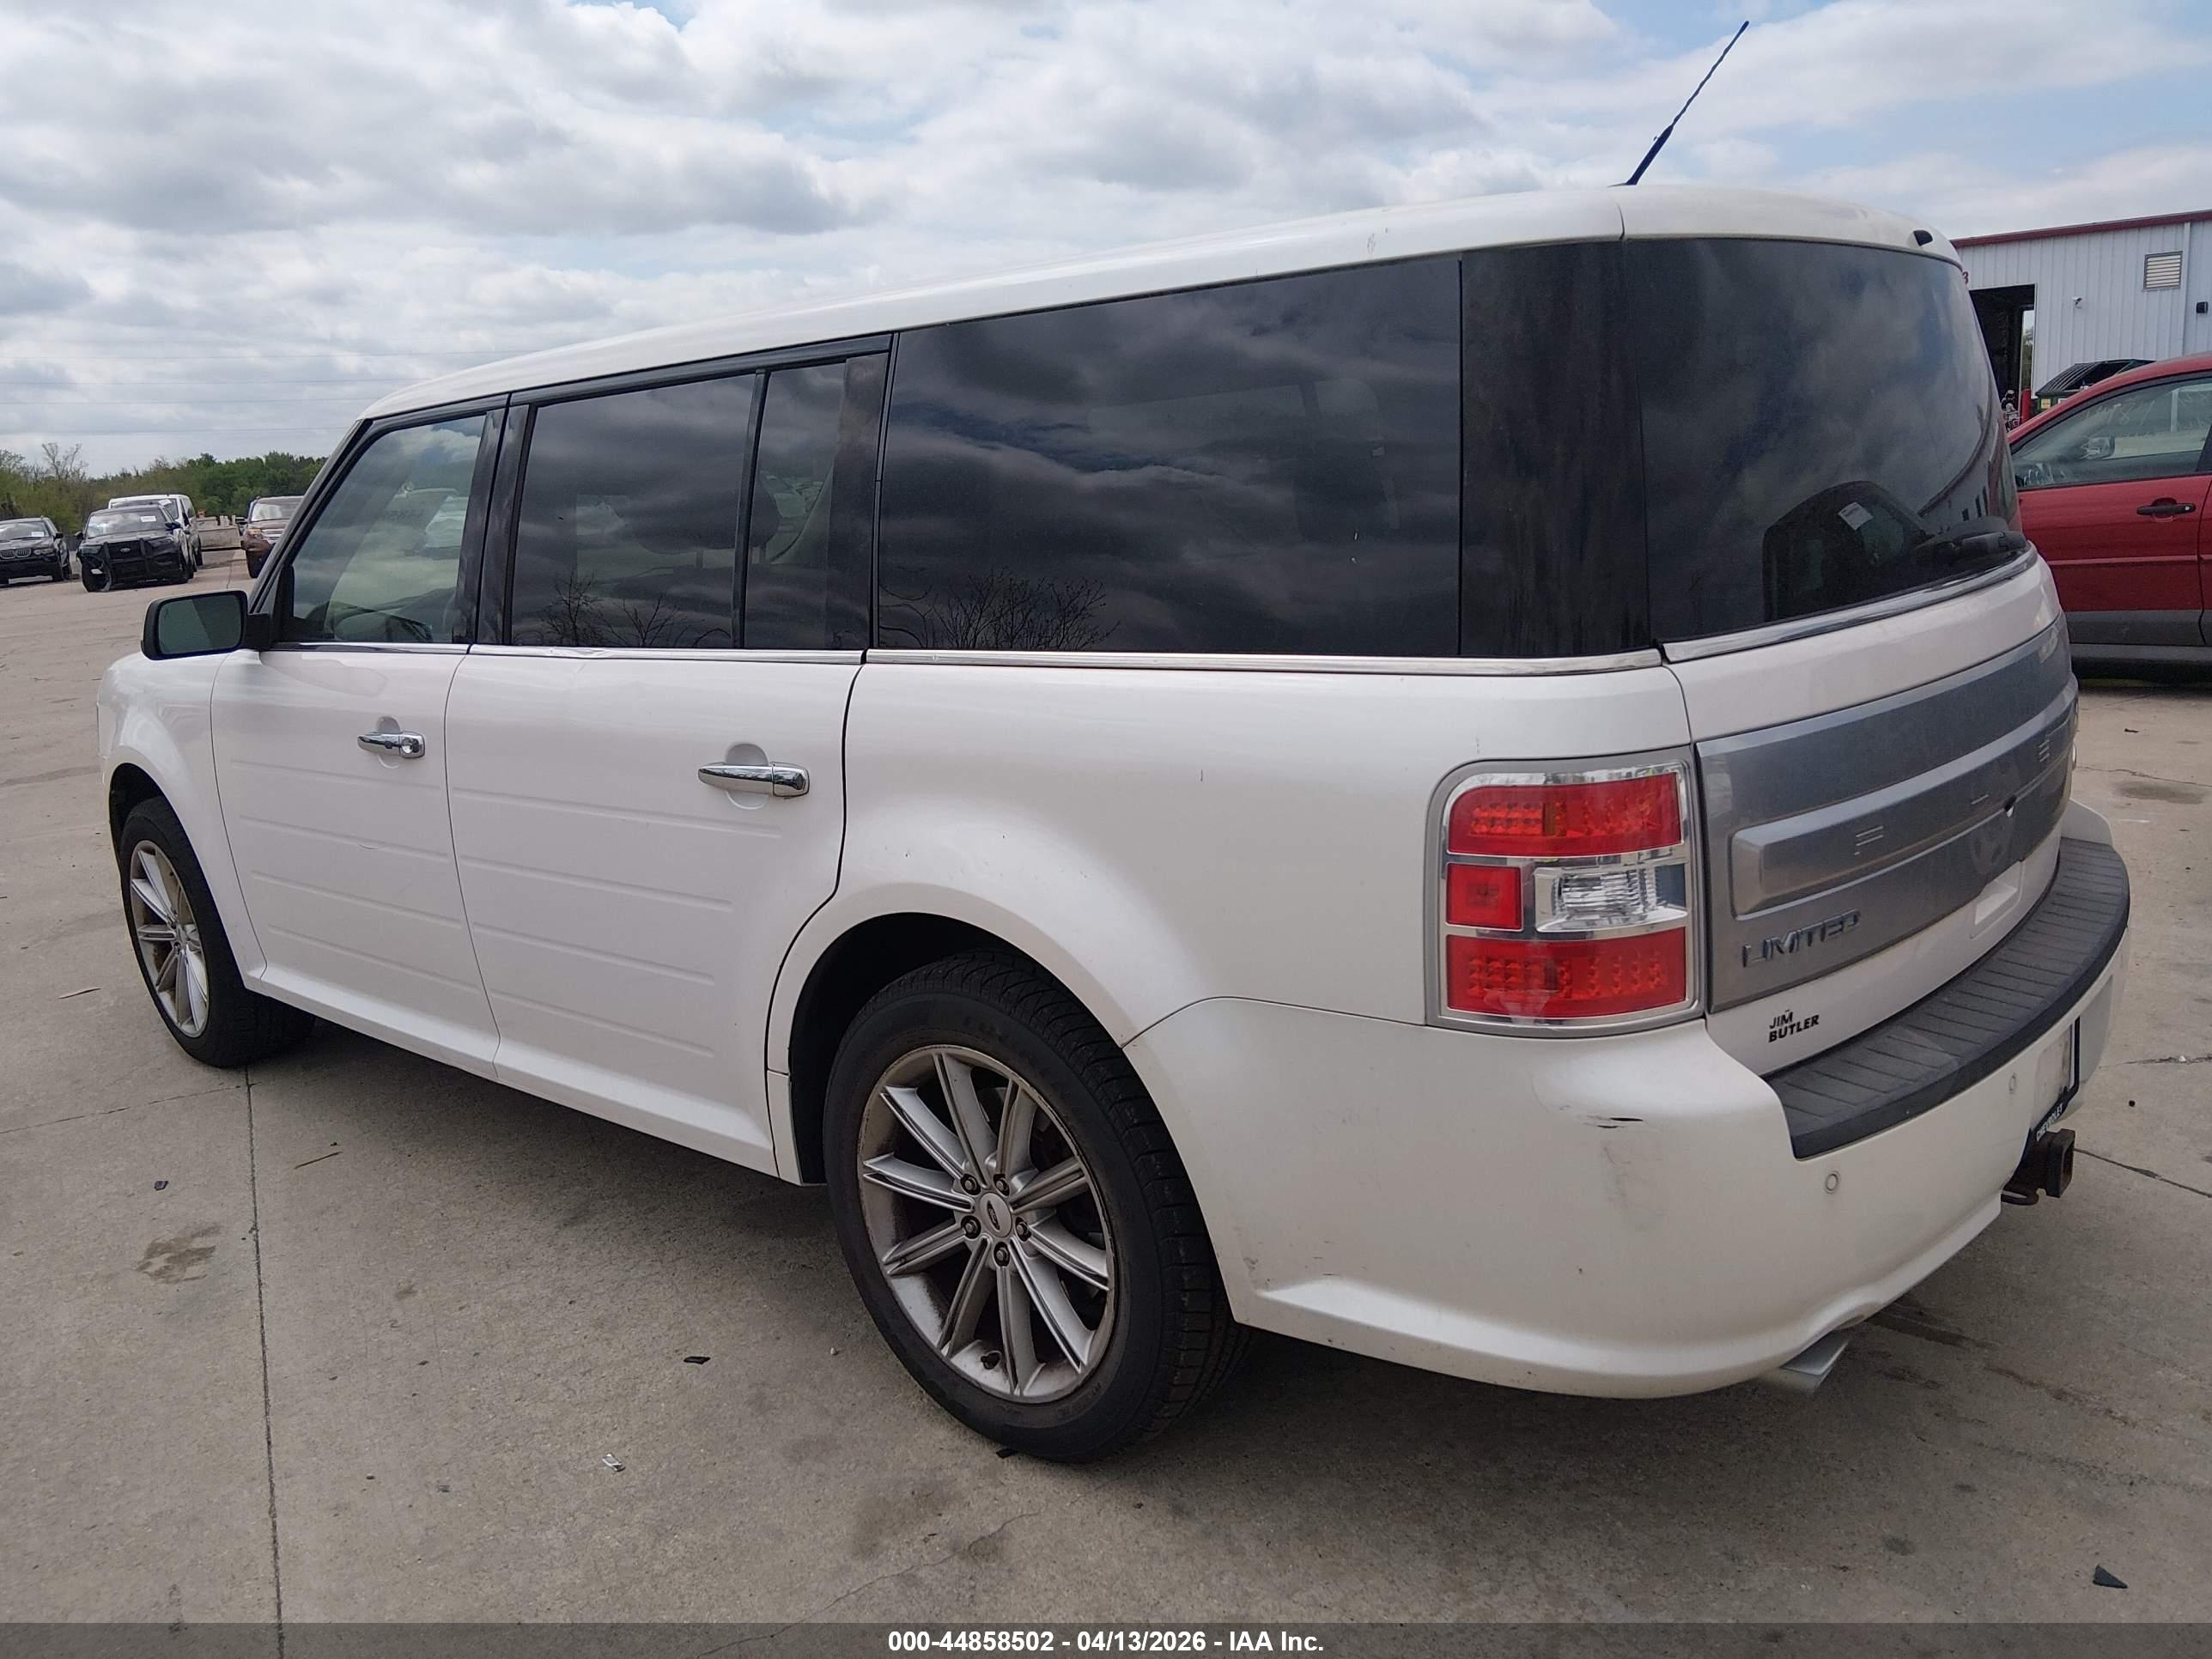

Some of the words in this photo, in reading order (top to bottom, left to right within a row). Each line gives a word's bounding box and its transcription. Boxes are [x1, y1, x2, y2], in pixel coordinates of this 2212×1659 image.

[1741, 909, 1861, 968] LIMITED
[1769, 1012, 1794, 1030] JIM
[1769, 1014, 1820, 1043] BUTLER
